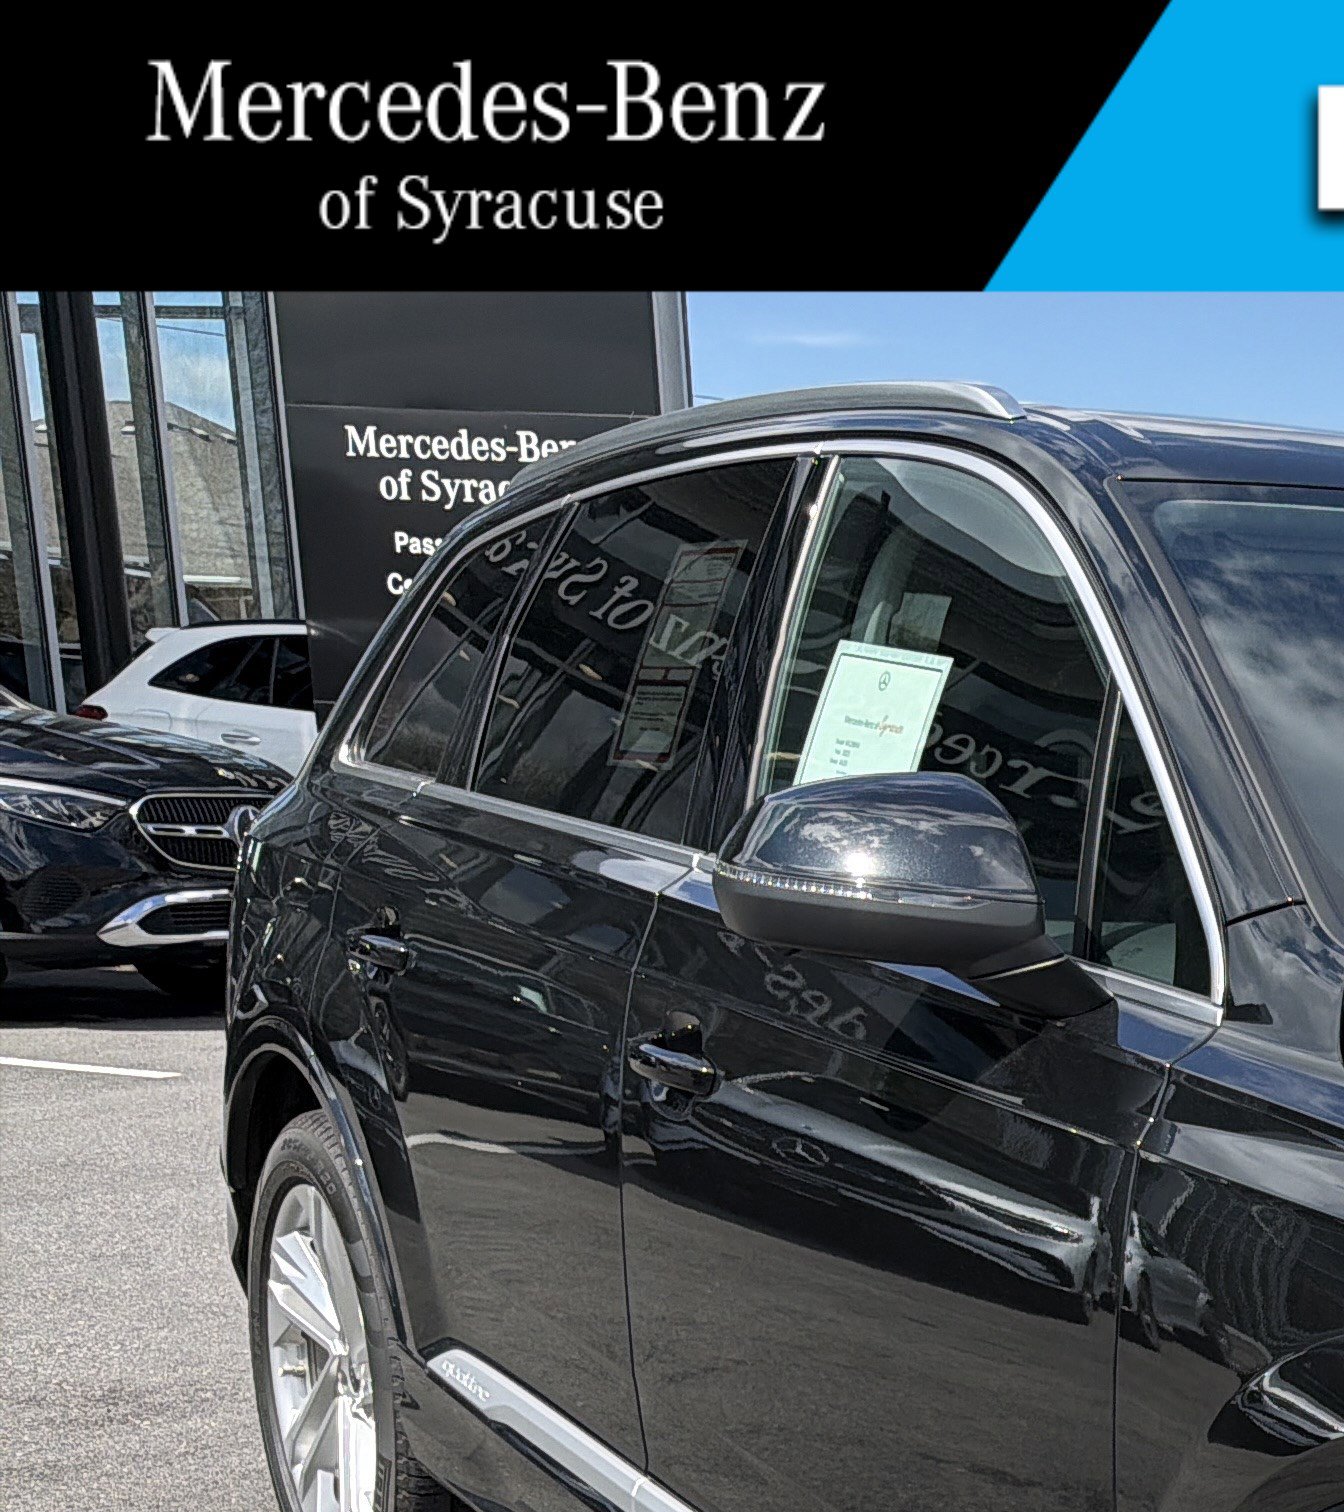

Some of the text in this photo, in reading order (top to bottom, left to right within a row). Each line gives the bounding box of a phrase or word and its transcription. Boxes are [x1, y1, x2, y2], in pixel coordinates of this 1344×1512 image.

[344, 424, 577, 463] Mercedes-Be
[379, 468, 511, 510] of Syrac
